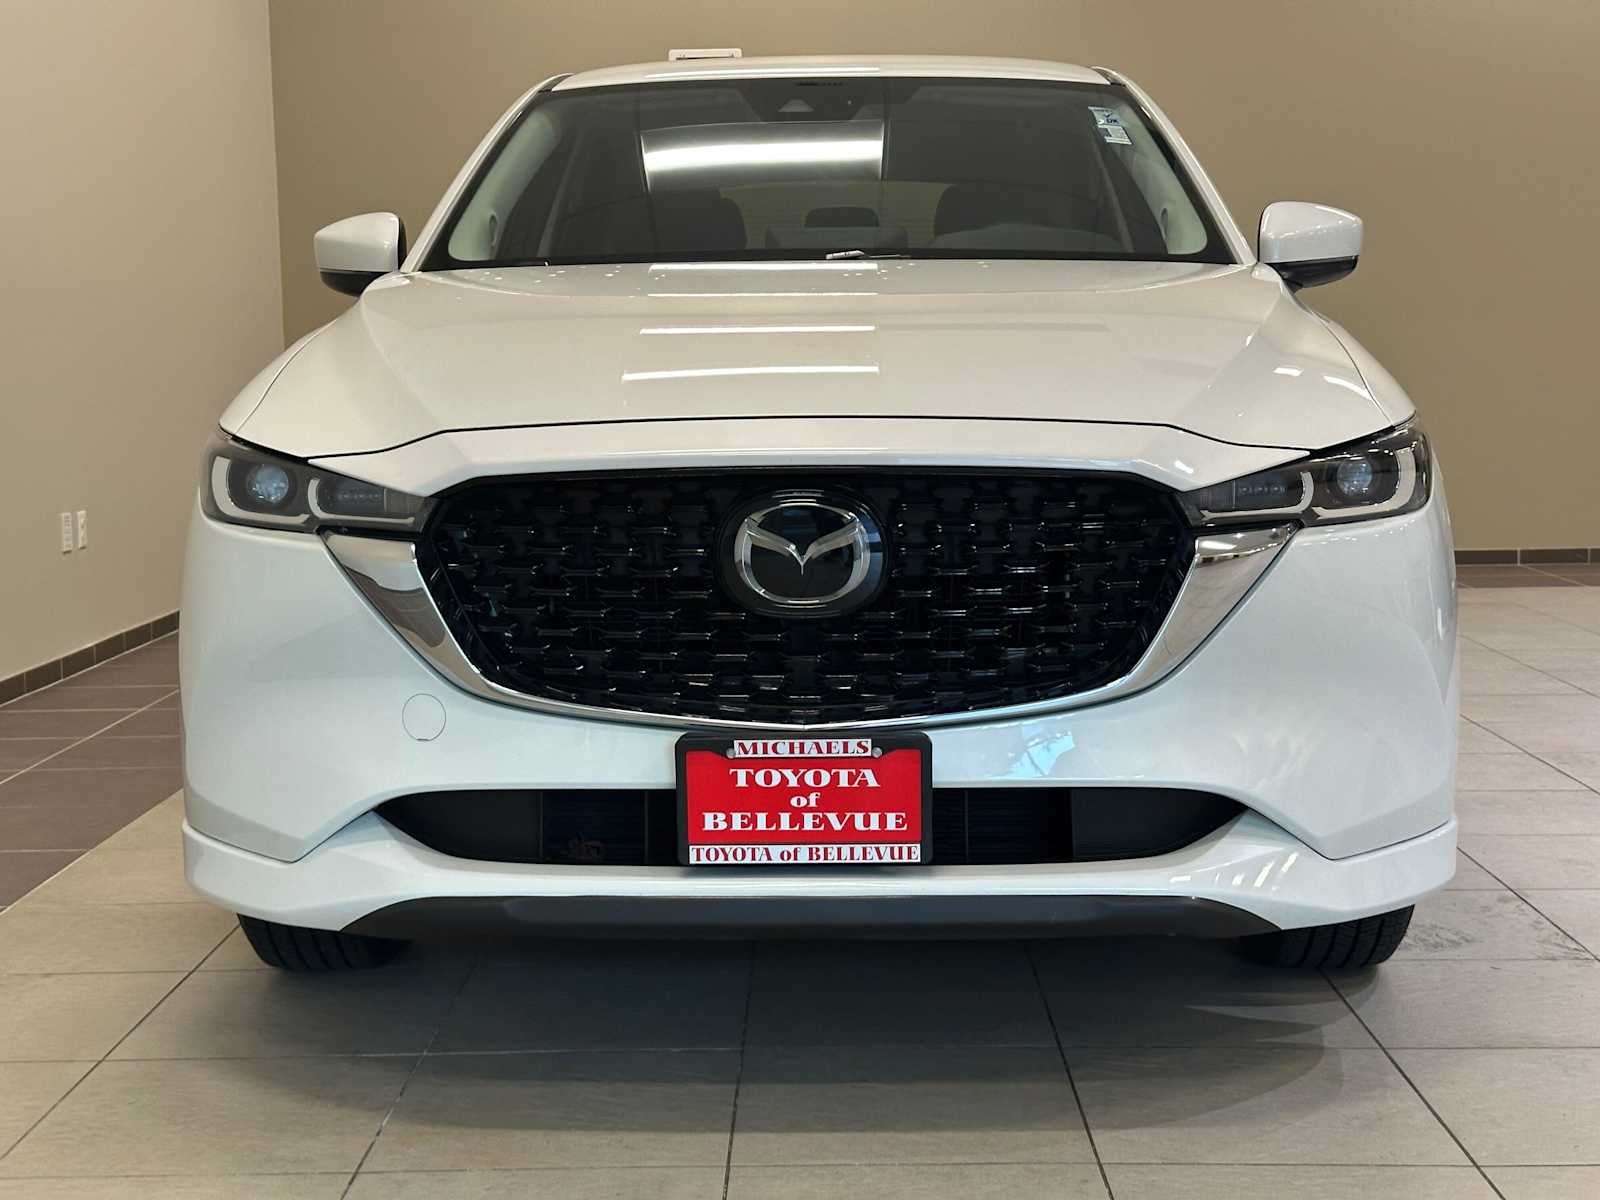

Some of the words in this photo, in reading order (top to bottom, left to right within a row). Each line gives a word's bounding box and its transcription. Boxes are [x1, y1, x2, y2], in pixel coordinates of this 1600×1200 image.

[737, 740, 870, 756] MICHAELS
[729, 768, 880, 788] TOYOTA
[790, 792, 821, 808] of
[702, 812, 907, 831] BELLEVUE
[692, 847, 773, 862] TOYOTA
[779, 847, 802, 862] of
[808, 845, 919, 861] BELLEVUE
